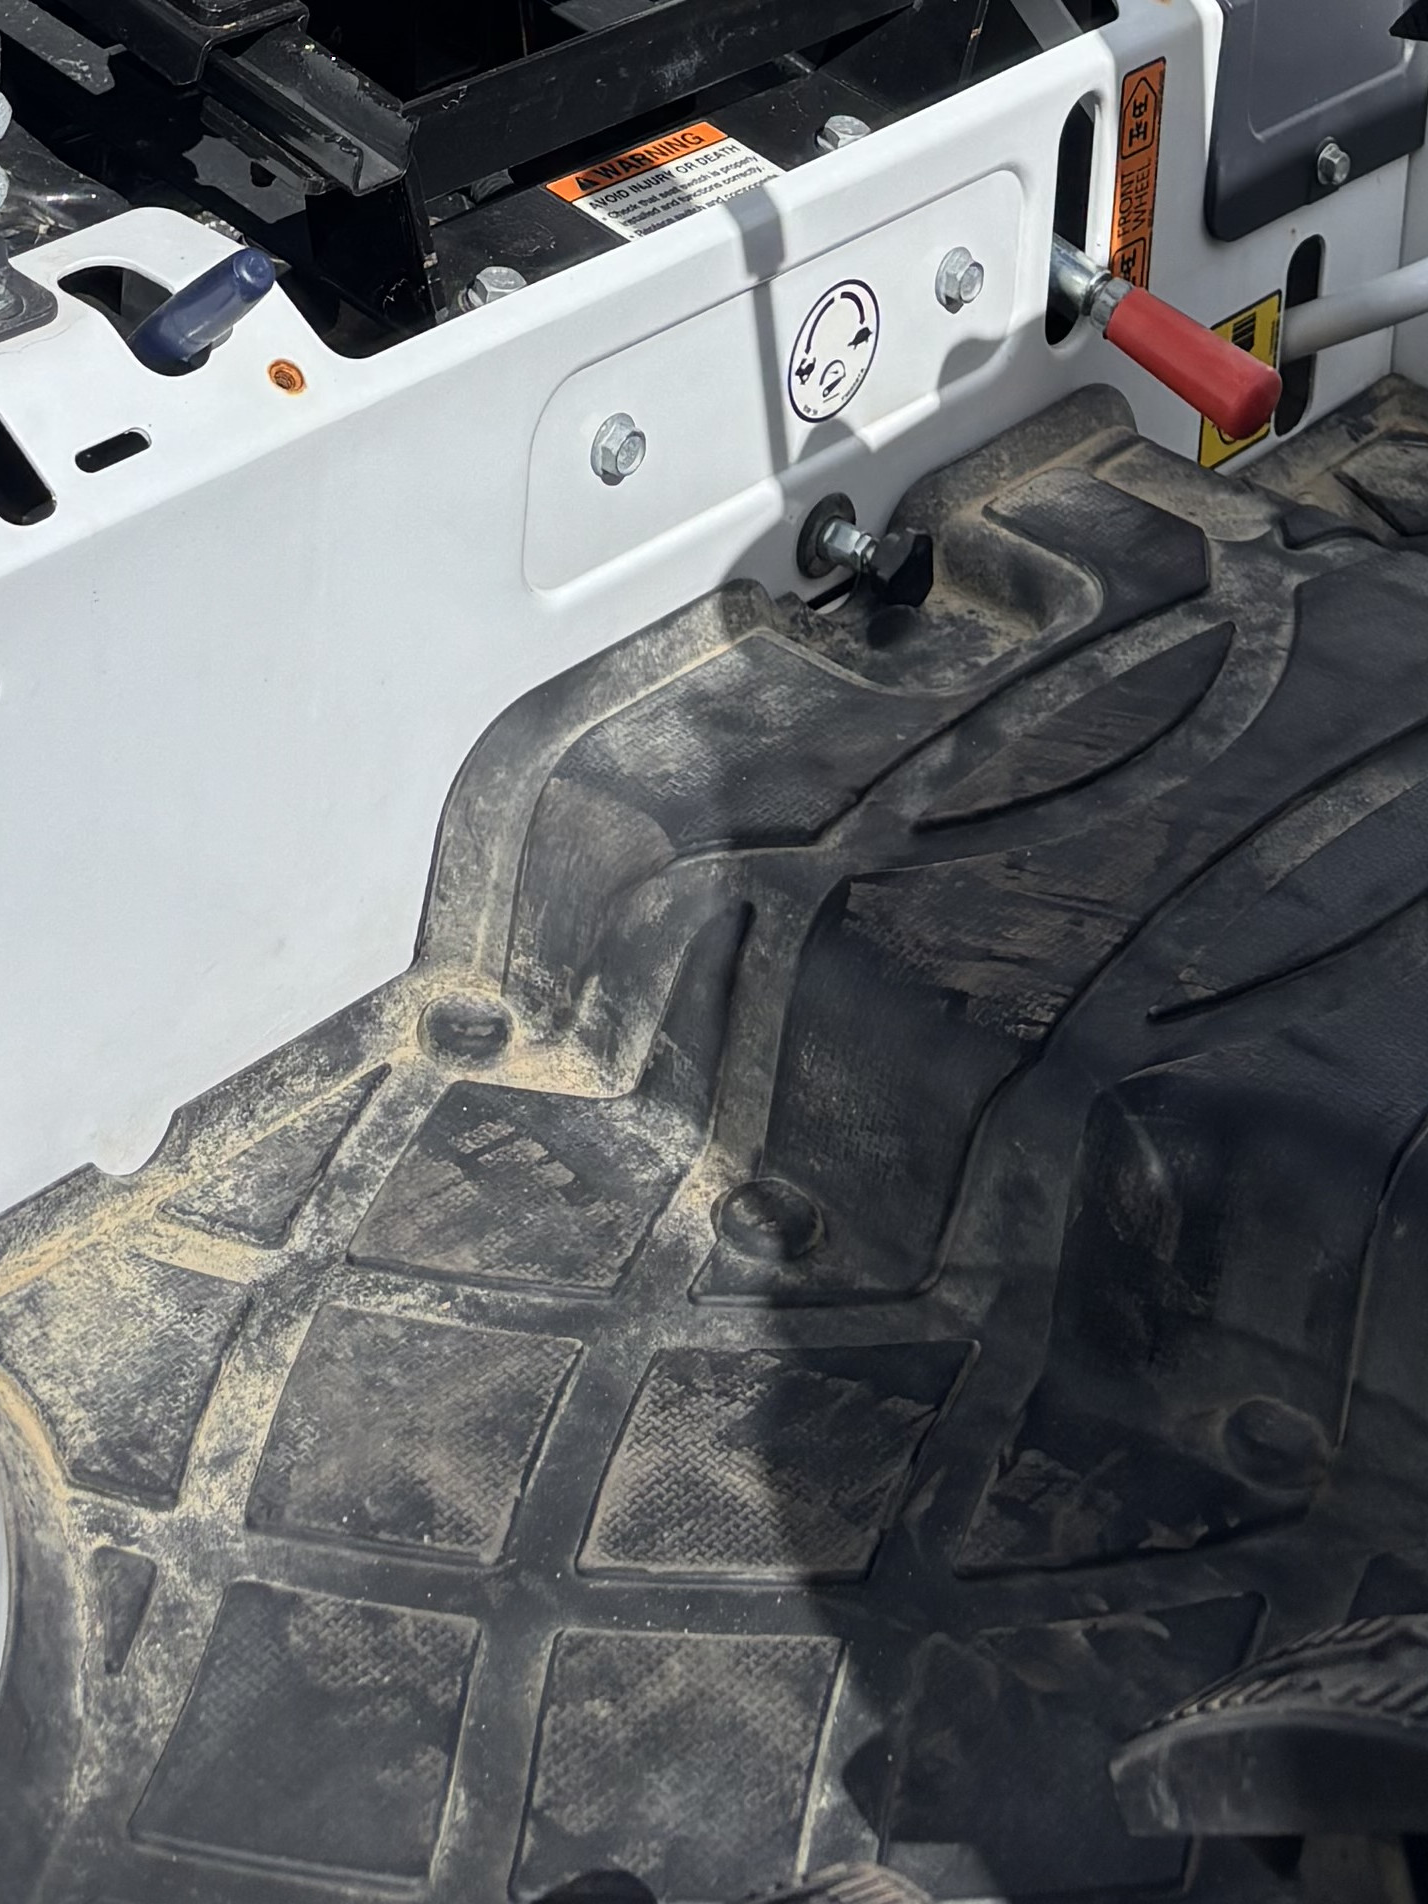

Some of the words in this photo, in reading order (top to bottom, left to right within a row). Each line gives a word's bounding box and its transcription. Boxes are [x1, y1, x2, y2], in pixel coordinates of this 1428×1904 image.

[589, 189, 630, 210] AVOID
[628, 170, 676, 194] INJURY
[675, 161, 698, 174] OR
[695, 145, 741, 166] DEATH
[592, 132, 705, 180] WARNING
[608, 203, 641, 219] Check
[638, 195, 660, 206] that
[679, 171, 712, 189] switch
[719, 156, 758, 174] properly
[660, 199, 681, 211] and
[1117, 169, 1134, 237] FRONT
[1132, 158, 1151, 230] WHEEL
